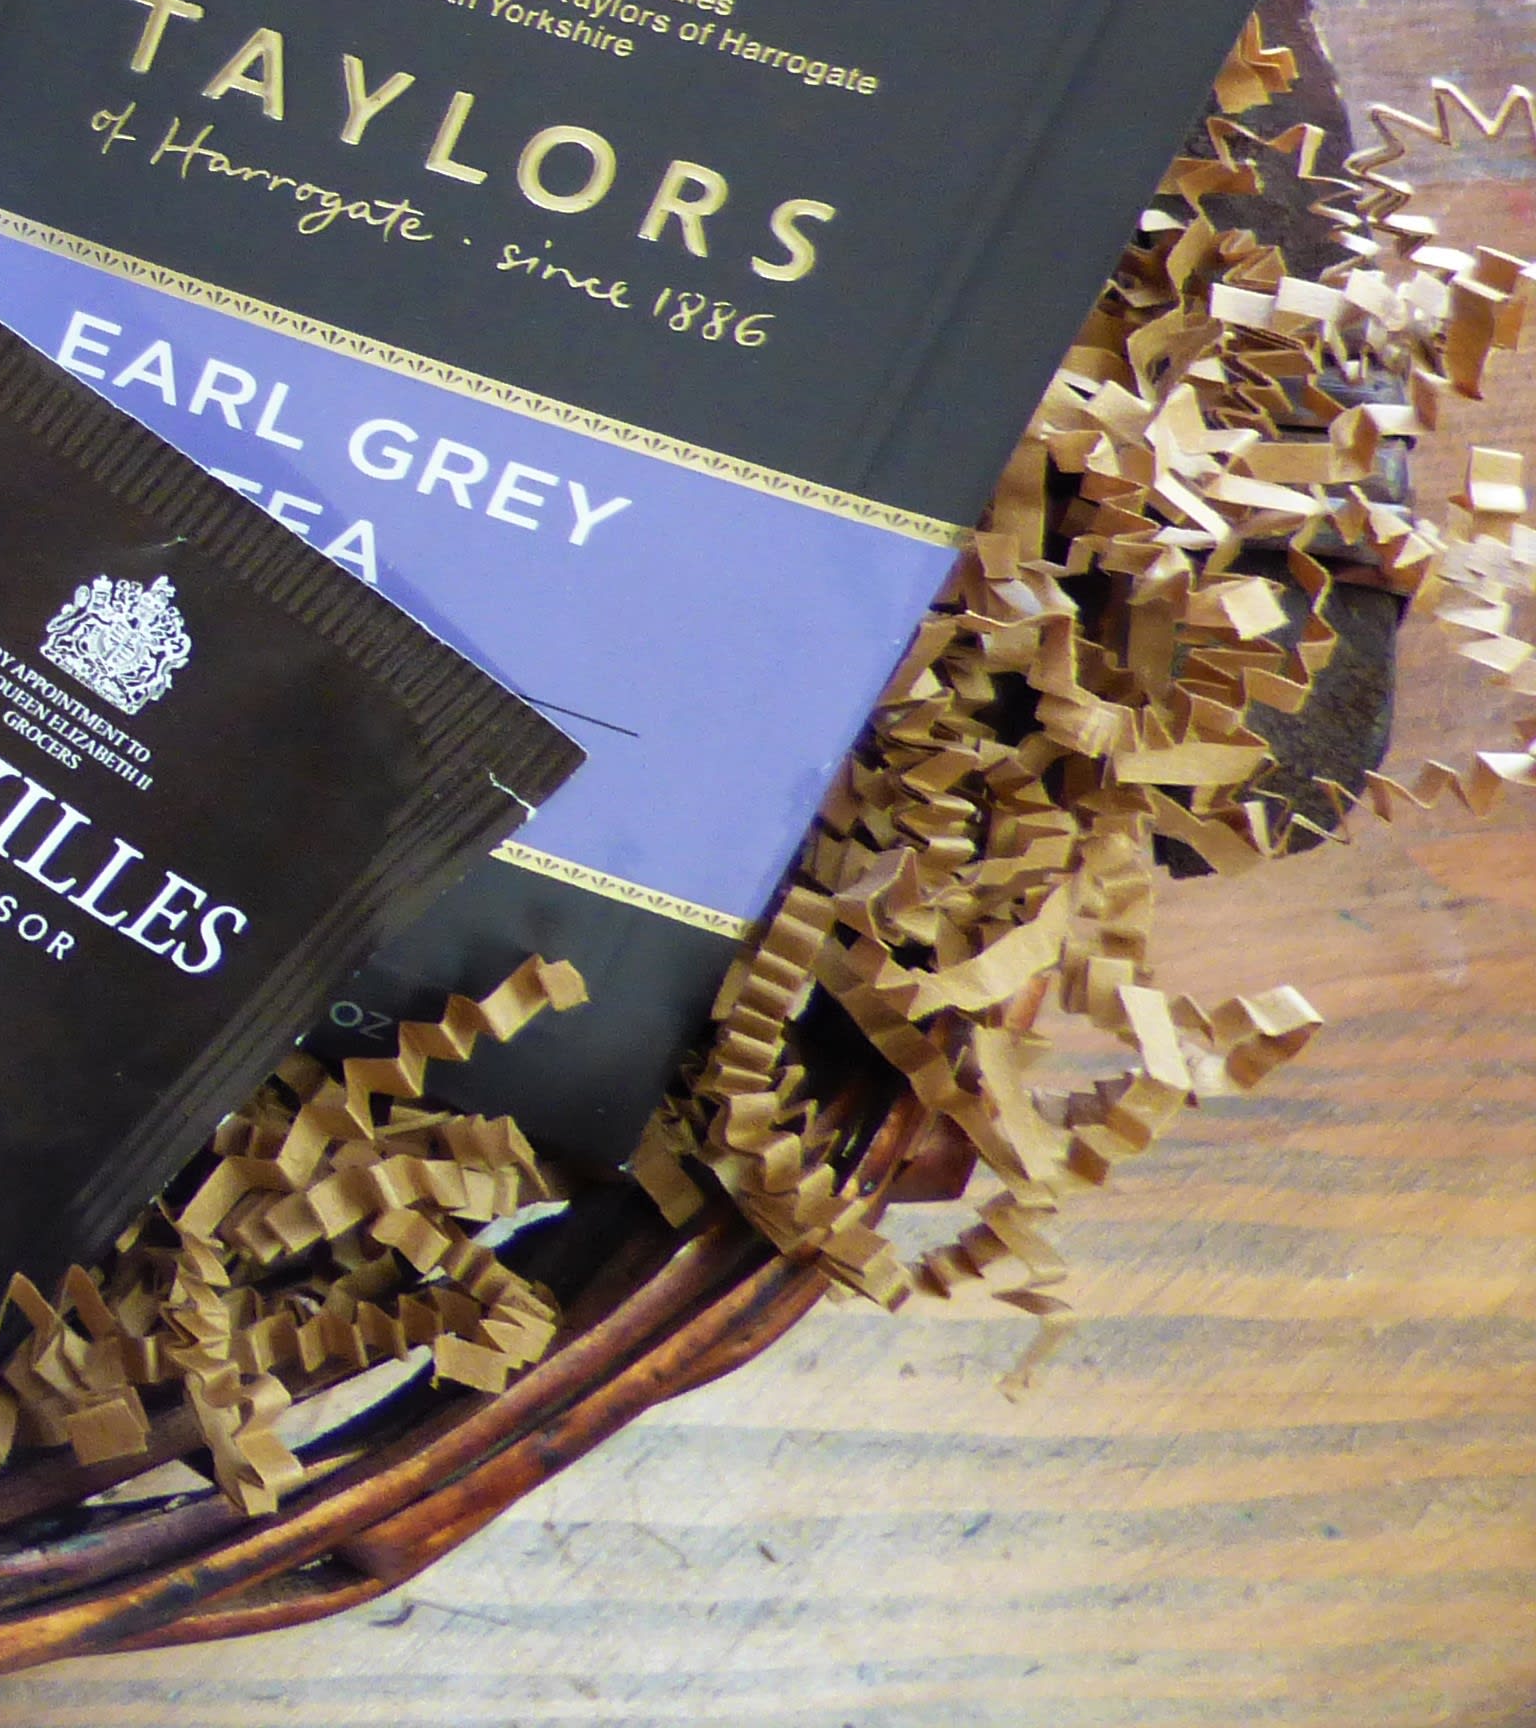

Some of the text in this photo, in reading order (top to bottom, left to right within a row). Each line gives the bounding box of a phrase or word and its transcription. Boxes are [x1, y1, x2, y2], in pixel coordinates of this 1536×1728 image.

[678, 13, 717, 46] of
[720, 28, 880, 98] Harrogate
[90, 101, 777, 349] of Harrogate since 1886
[55, 309, 633, 548] EARL GREY
[2, 709, 84, 773] GROCERS
[9, 660, 128, 749] APPOINTMENT
[122, 734, 152, 764] TO
[45, 710, 140, 785] ELIZABETH
[134, 772, 154, 792] II
